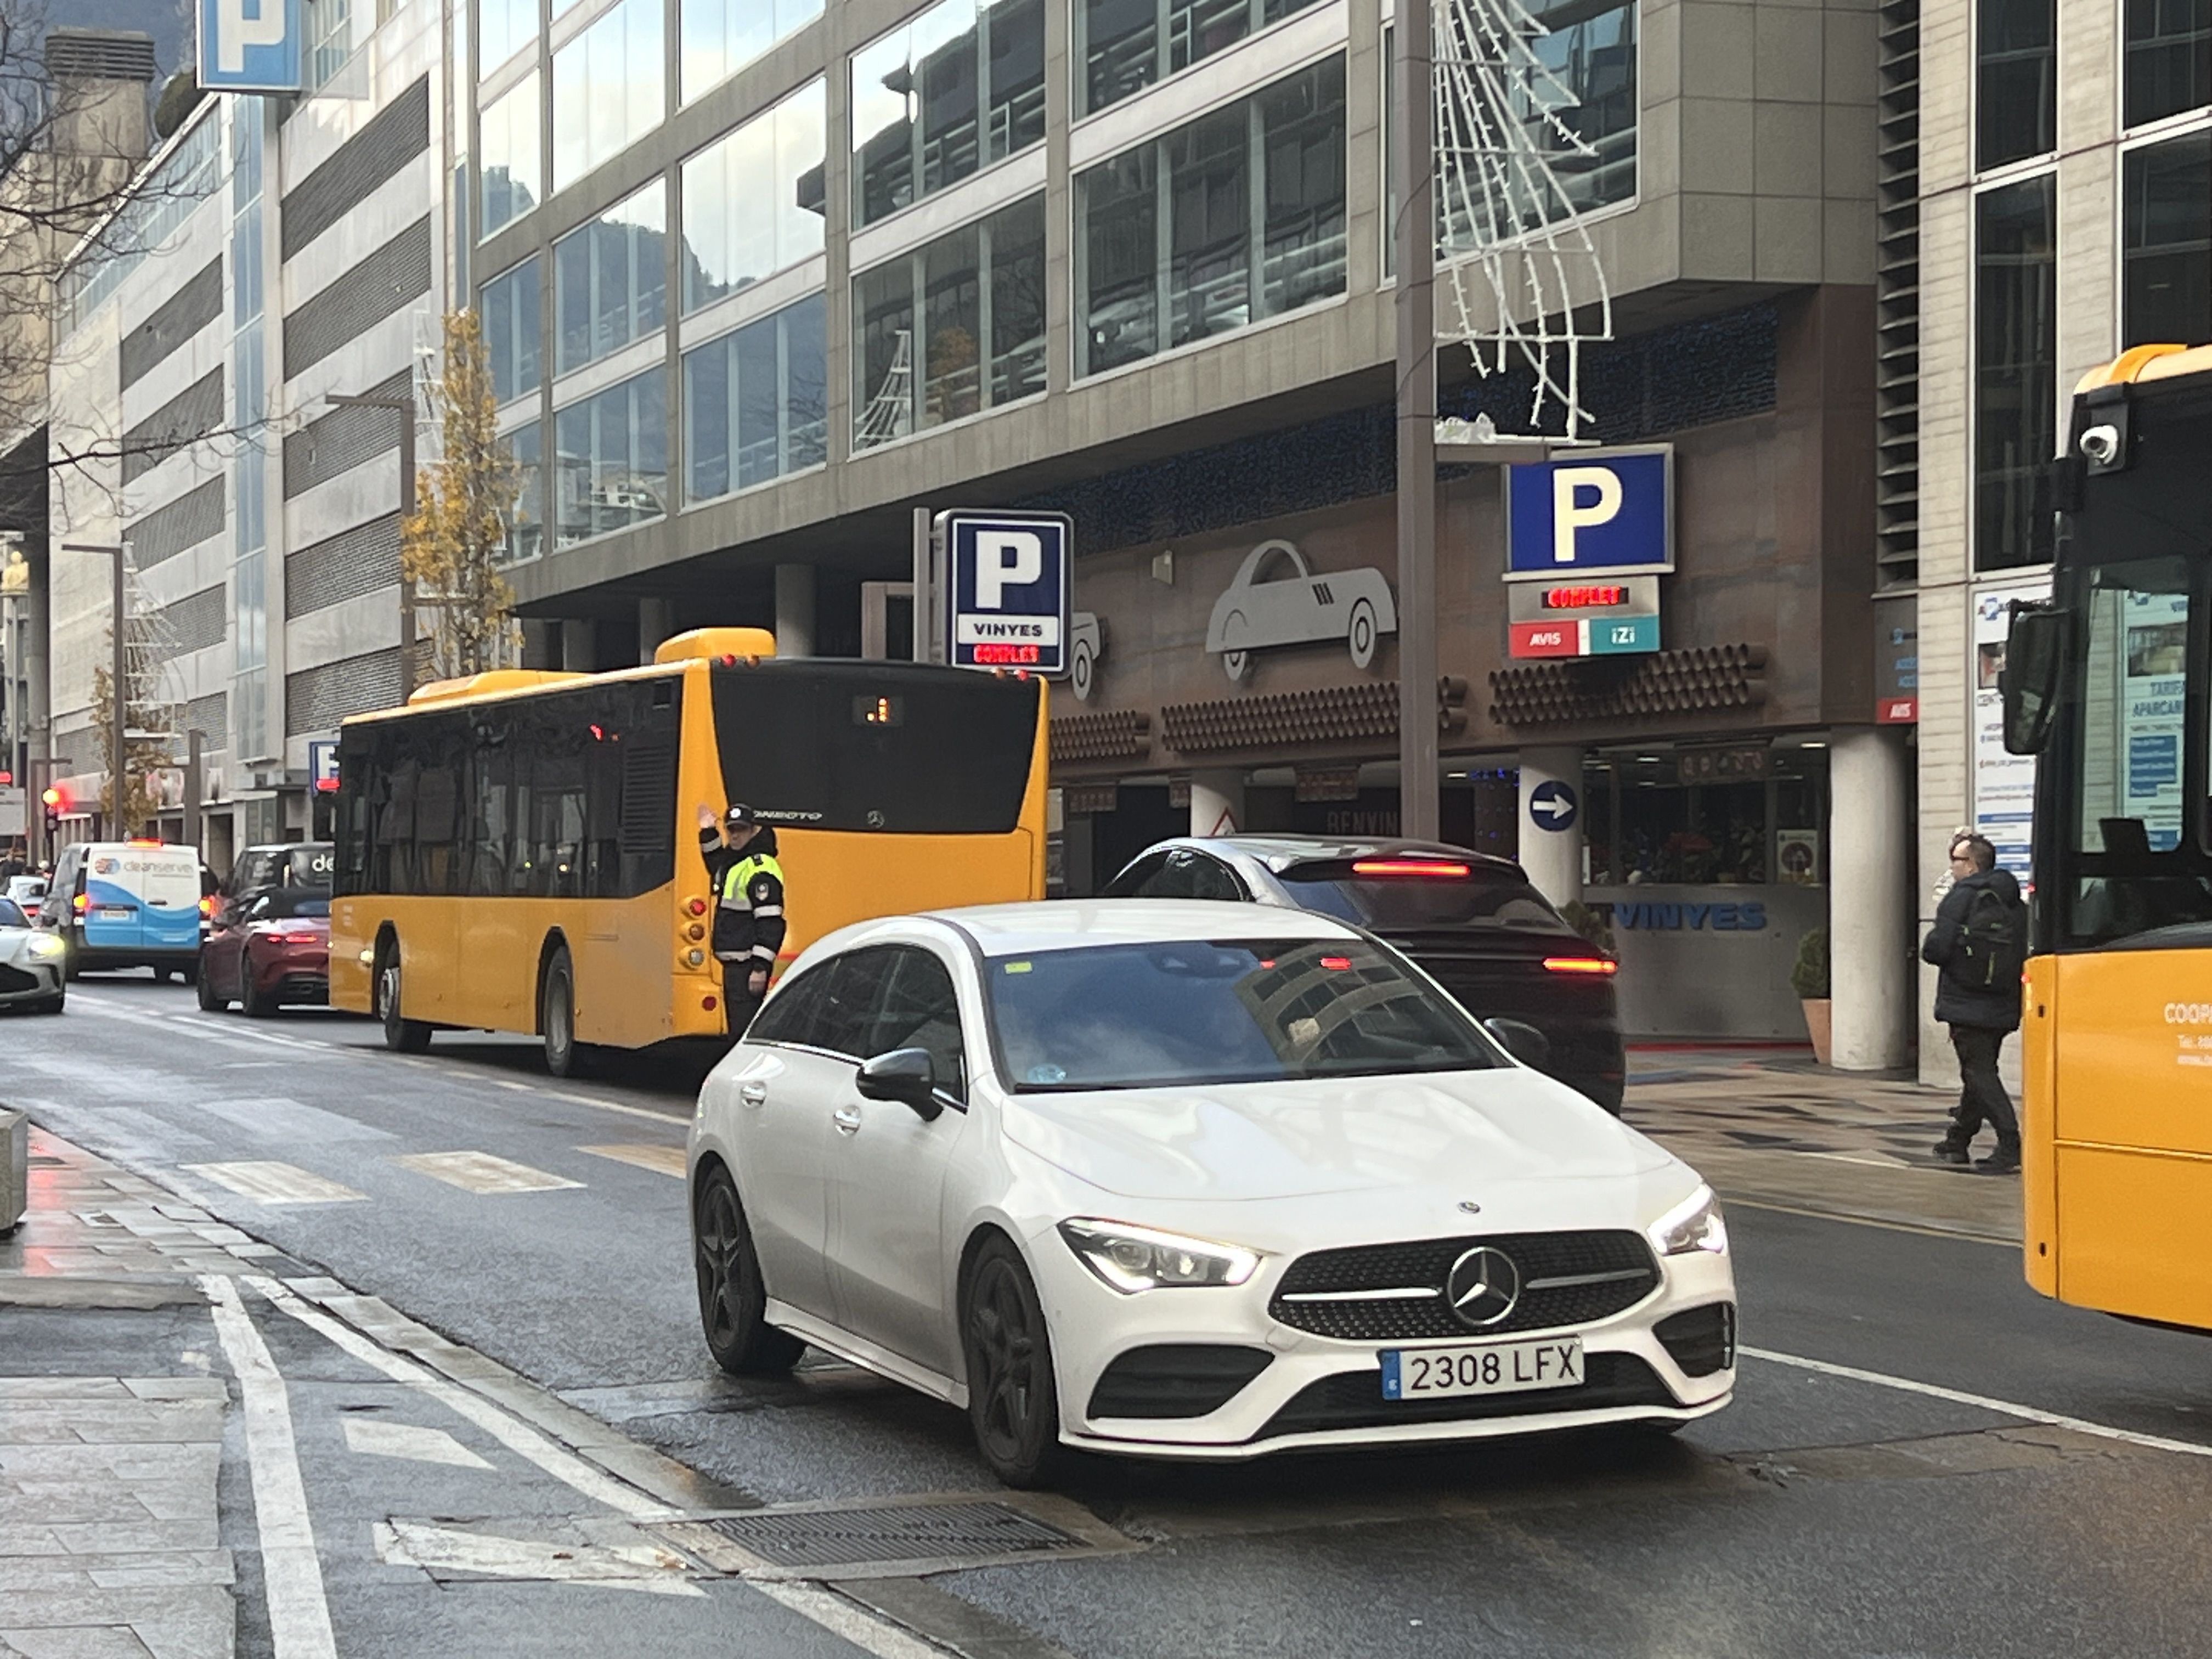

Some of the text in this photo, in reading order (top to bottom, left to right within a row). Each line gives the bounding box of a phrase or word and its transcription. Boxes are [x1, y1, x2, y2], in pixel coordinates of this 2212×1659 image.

[217, 0, 285, 73] P
[1553, 467, 1622, 562] P
[975, 531, 1041, 609] P
[1548, 585, 1621, 608] COMPLET
[974, 623, 1042, 636] VINYES
[1529, 632, 1561, 646] AVIS
[973, 645, 1039, 663] COMPLET
[1614, 902, 1767, 930] VINYES
[2164, 1002, 2212, 1024] COOP
[1410, 1345, 1576, 1391] 2308 LFX
